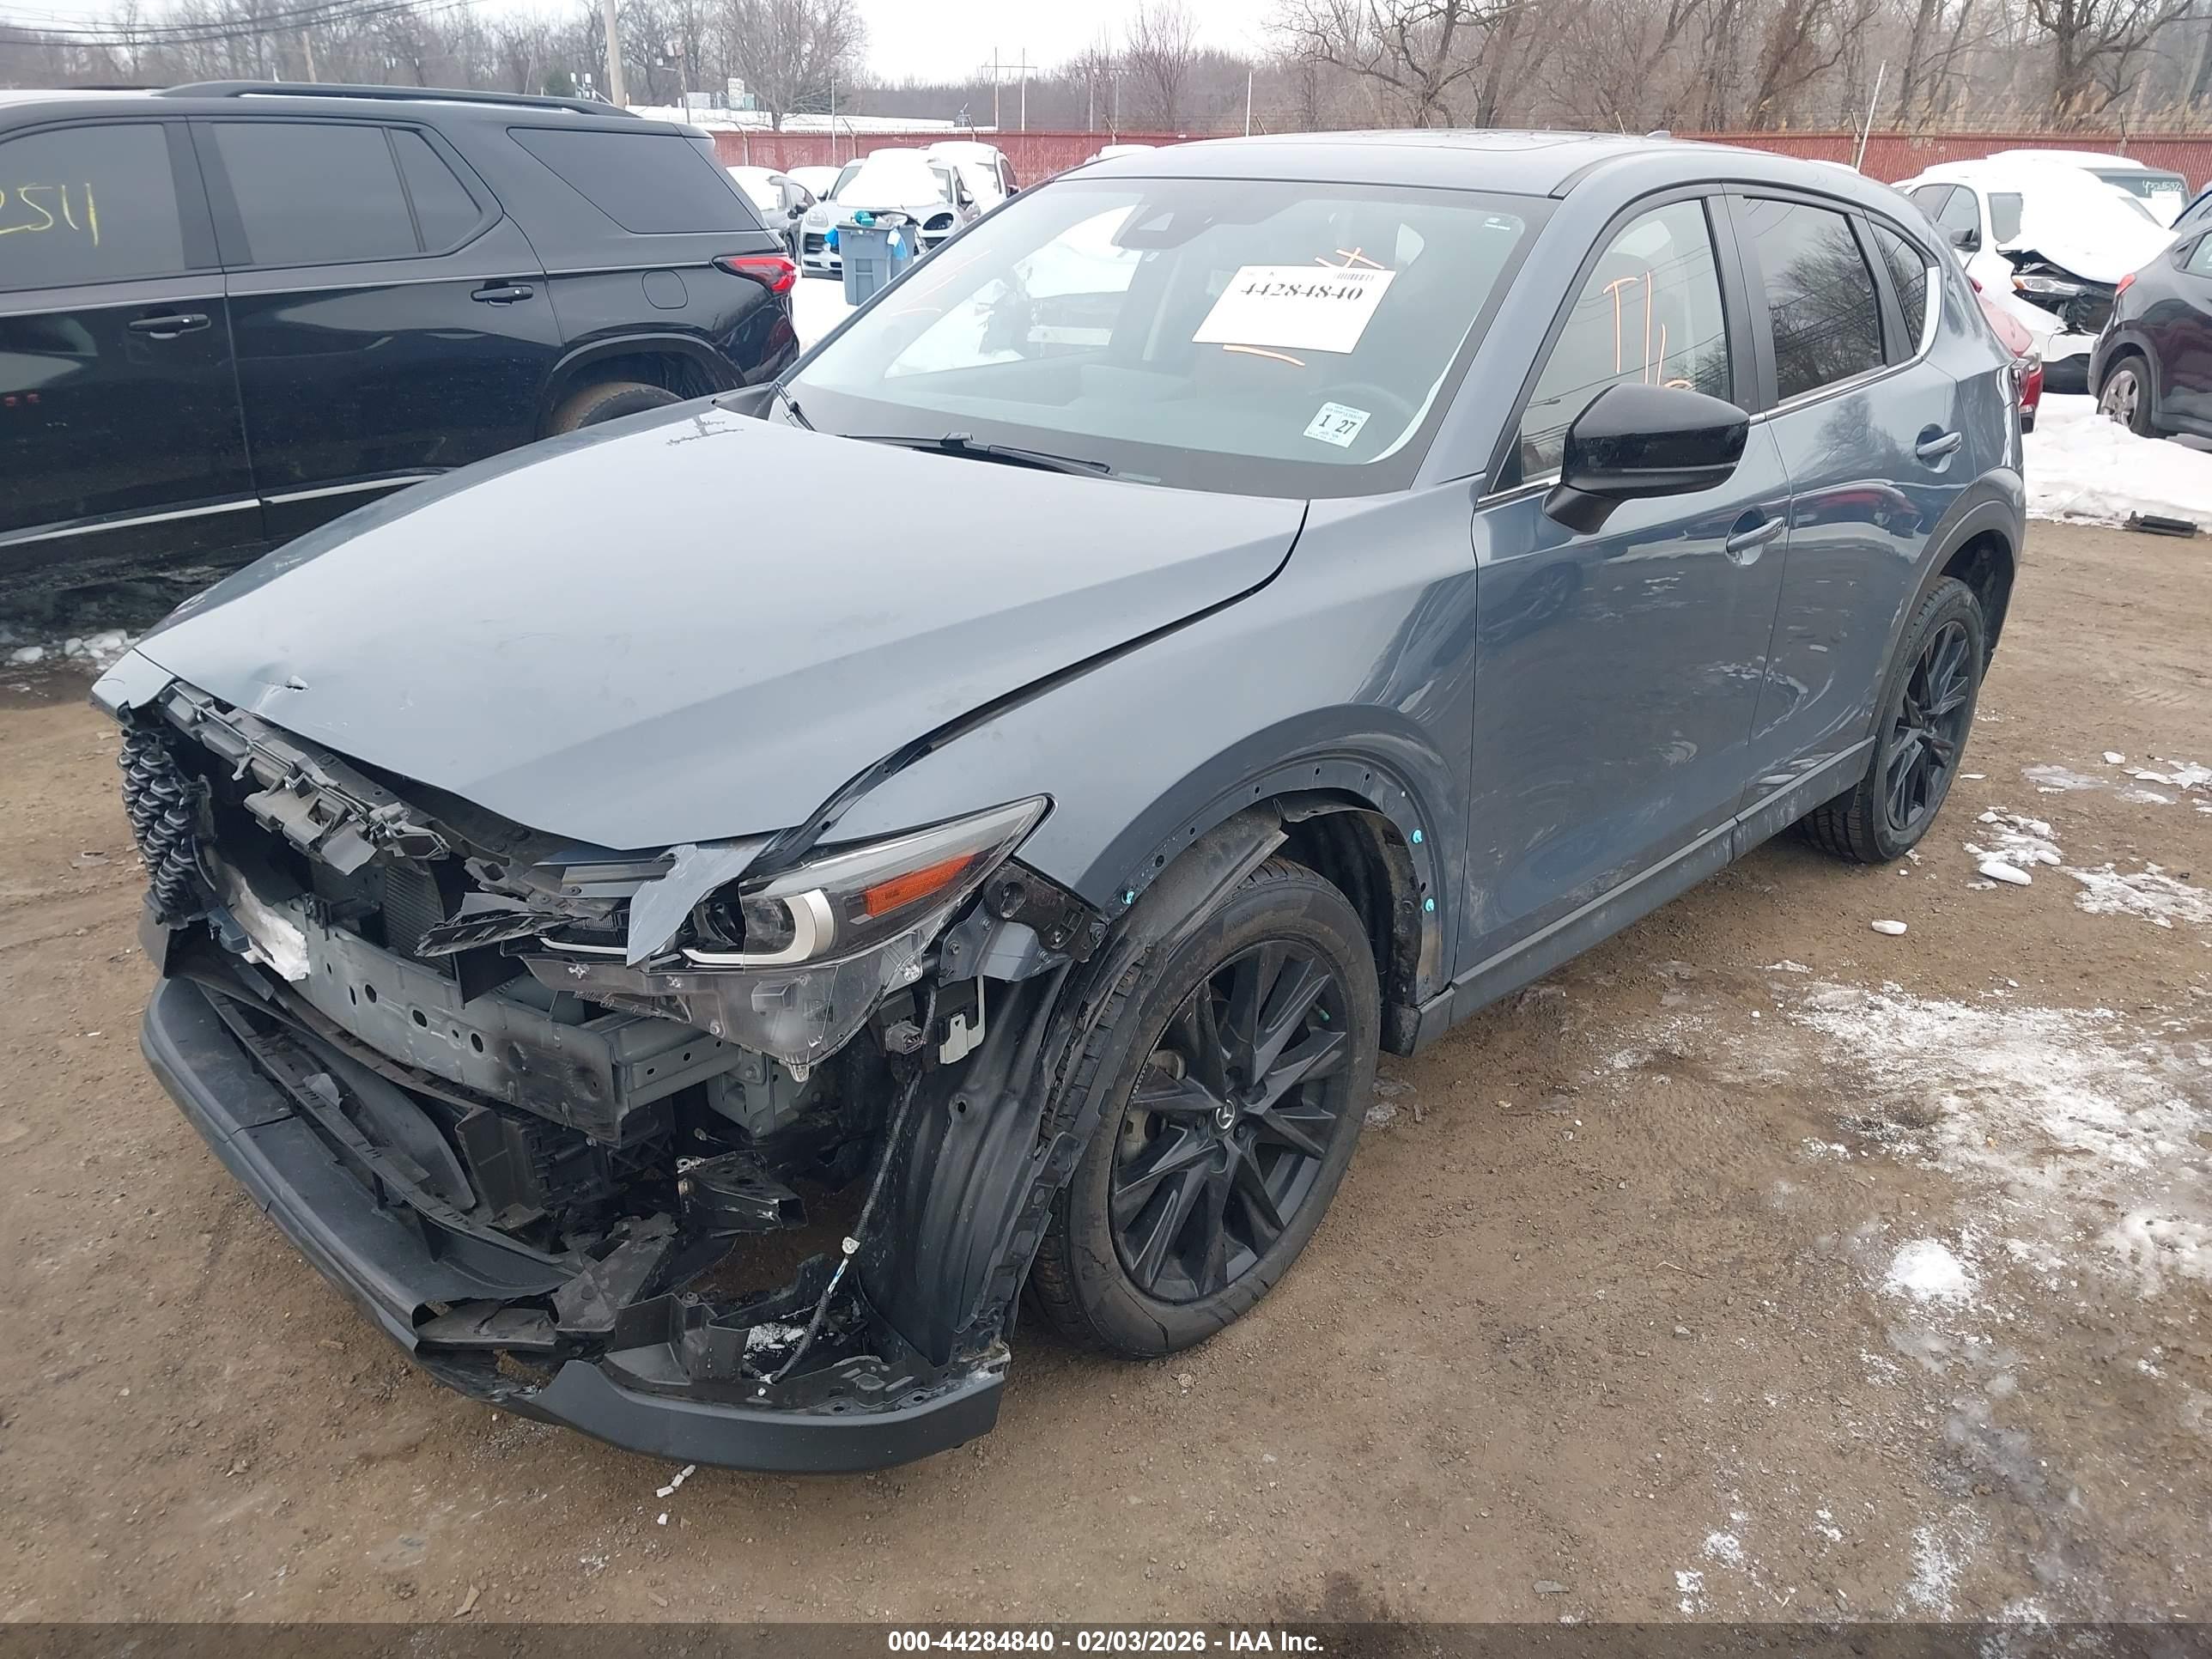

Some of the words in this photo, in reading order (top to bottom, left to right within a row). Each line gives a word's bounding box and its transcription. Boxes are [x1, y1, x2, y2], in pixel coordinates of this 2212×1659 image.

[1241, 283, 1364, 301] 44284840
[1318, 414, 1332, 428] 1
[1334, 419, 1357, 434] 27
